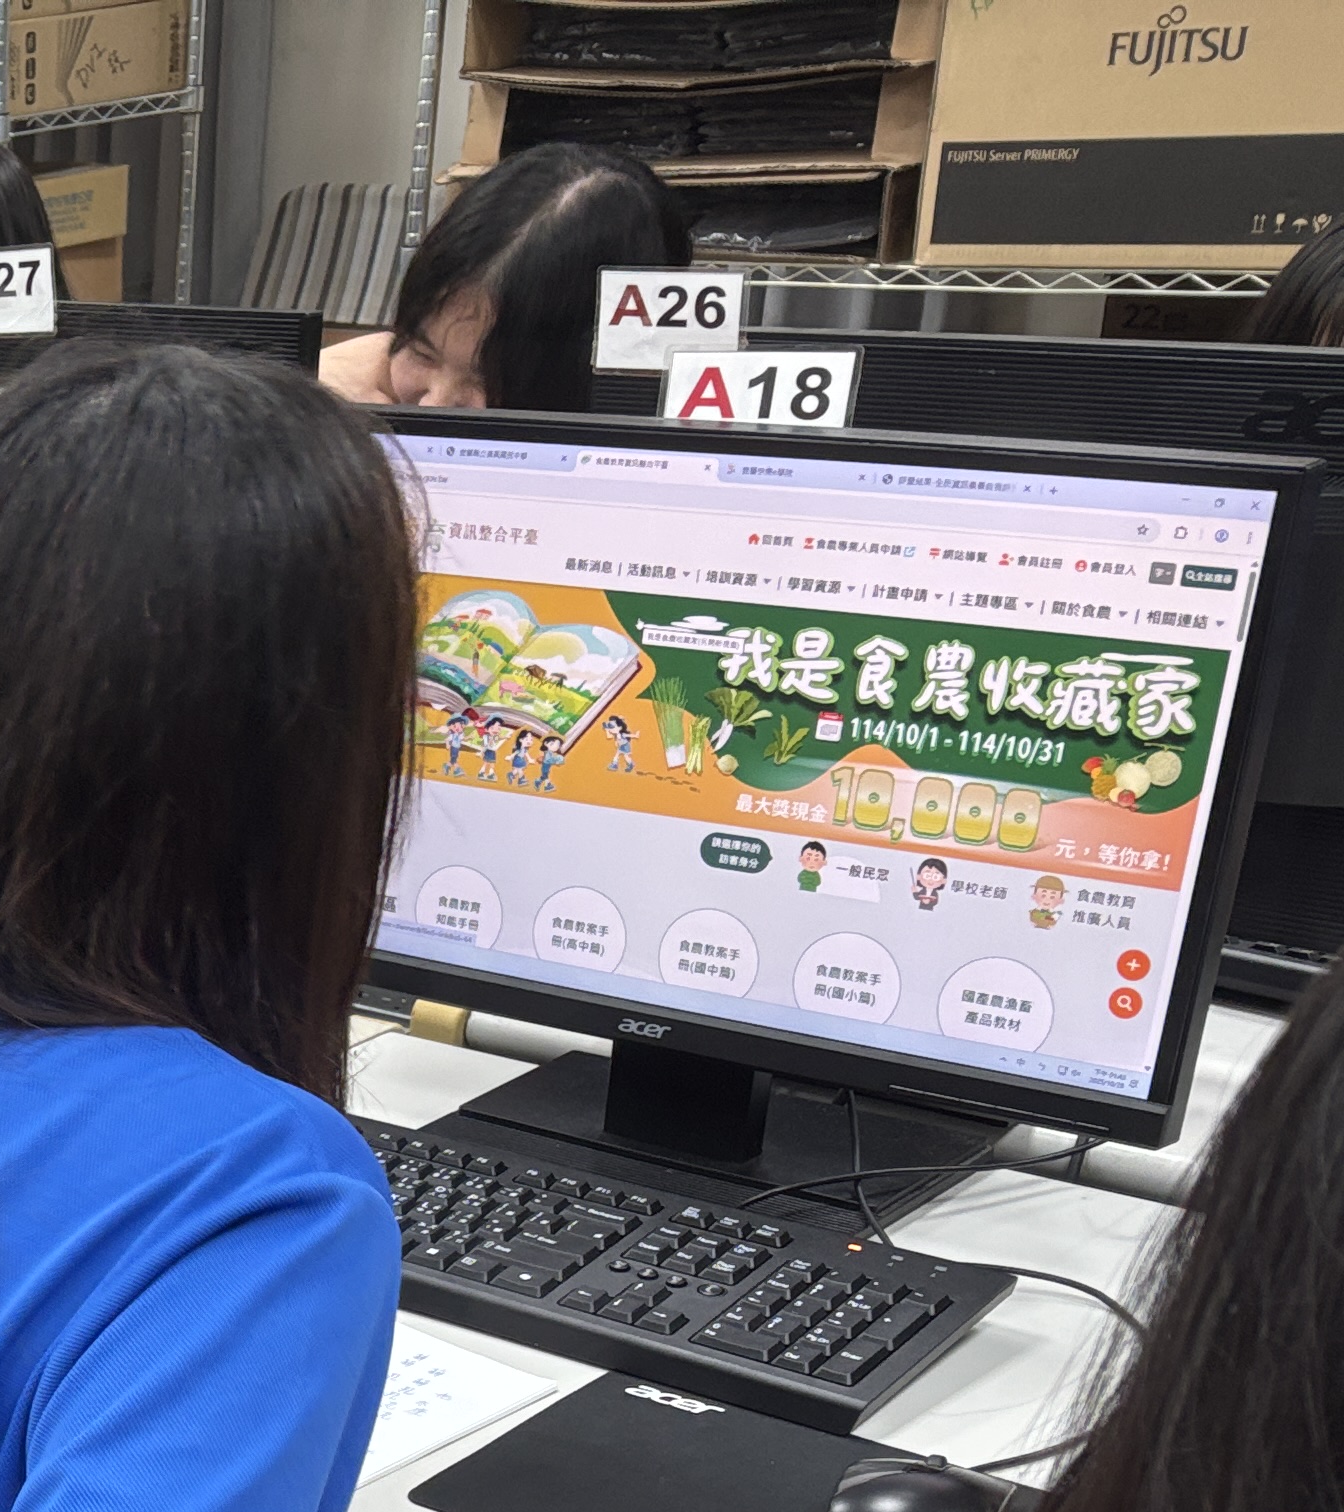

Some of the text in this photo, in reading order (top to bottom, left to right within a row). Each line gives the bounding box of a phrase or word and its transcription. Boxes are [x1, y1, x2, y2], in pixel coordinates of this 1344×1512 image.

[1107, 22, 1249, 77] FUJITSU
[947, 147, 1080, 163] FUJITSU Server PRIMERGY
[609, 285, 727, 329] A26
[676, 366, 833, 421] A18
[449, 522, 539, 546] 資訊整合平臺
[761, 533, 794, 547] 回首頁
[942, 548, 988, 564] 網站導覽
[1017, 554, 1063, 570] 會員註冊
[1090, 561, 1137, 576] 會員登入
[565, 557, 1209, 629] 最新消息 活動訊息 培訓資源 學習資源 計畫申請 主題專區 關於食農 相關連結
[720, 628, 1201, 737] 我是食農收藏家
[849, 717, 939, 748] 114/10/1
[957, 729, 1065, 764] 114/10/31
[735, 791, 828, 824] 最大獎現金
[830, 765, 1043, 851] 10,000
[835, 862, 890, 883] 一般民眾
[950, 879, 1008, 900] 學校老師
[1077, 888, 1137, 910] 食農教育
[438, 895, 481, 914] 食農教育
[436, 913, 479, 931] 知能手冊
[551, 916, 610, 938] 食農教案手
[1072, 909, 1132, 931] 推廣人員
[551, 934, 606, 957] 冊(高中篇)
[679, 939, 741, 961] 食農教案手
[677, 958, 736, 982] 冊(國中篇)
[815, 963, 882, 986] 食農教案手
[813, 983, 877, 1007] 冊(國小篇)
[961, 989, 1033, 1014] 國產農漁畜
[618, 1017, 672, 1040] acer
[964, 1010, 1022, 1033] 產品教材
[624, 1384, 726, 1414] acer
